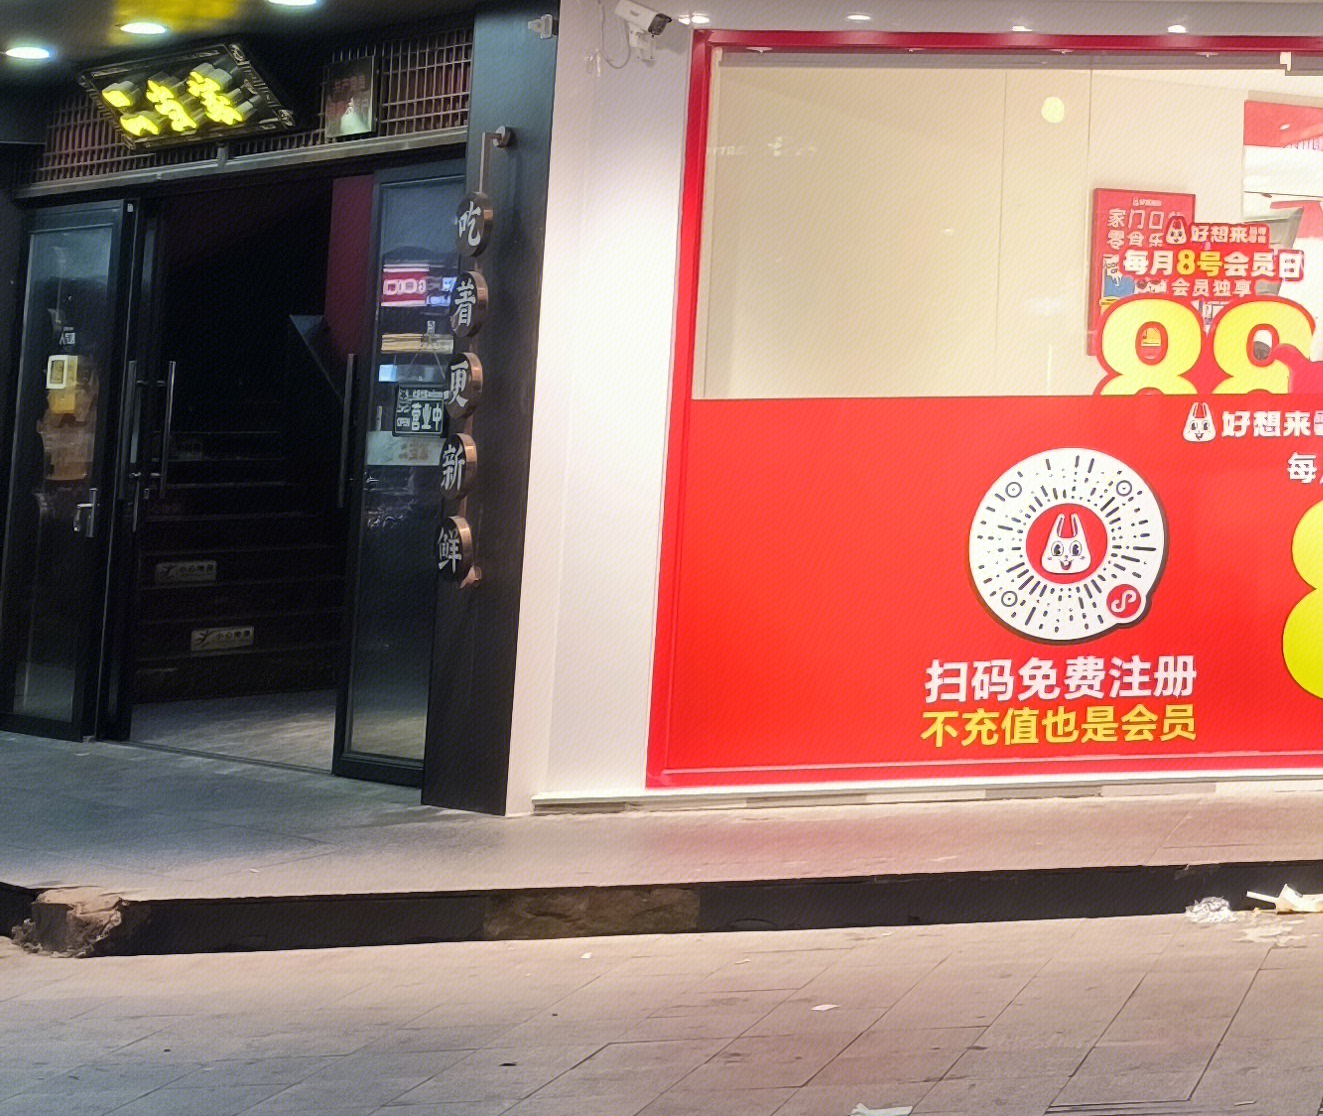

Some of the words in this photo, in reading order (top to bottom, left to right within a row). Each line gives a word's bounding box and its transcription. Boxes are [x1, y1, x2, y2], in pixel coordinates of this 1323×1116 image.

[1190, 225, 1249, 244] 好想来
[1123, 248, 1303, 280] 每月8号会员日
[1171, 277, 1252, 298] 会员独享
[1220, 410, 1311, 438] 好想来
[924, 654, 1197, 703] 扫码免费注册
[921, 702, 1198, 747] 不充值也是会员
